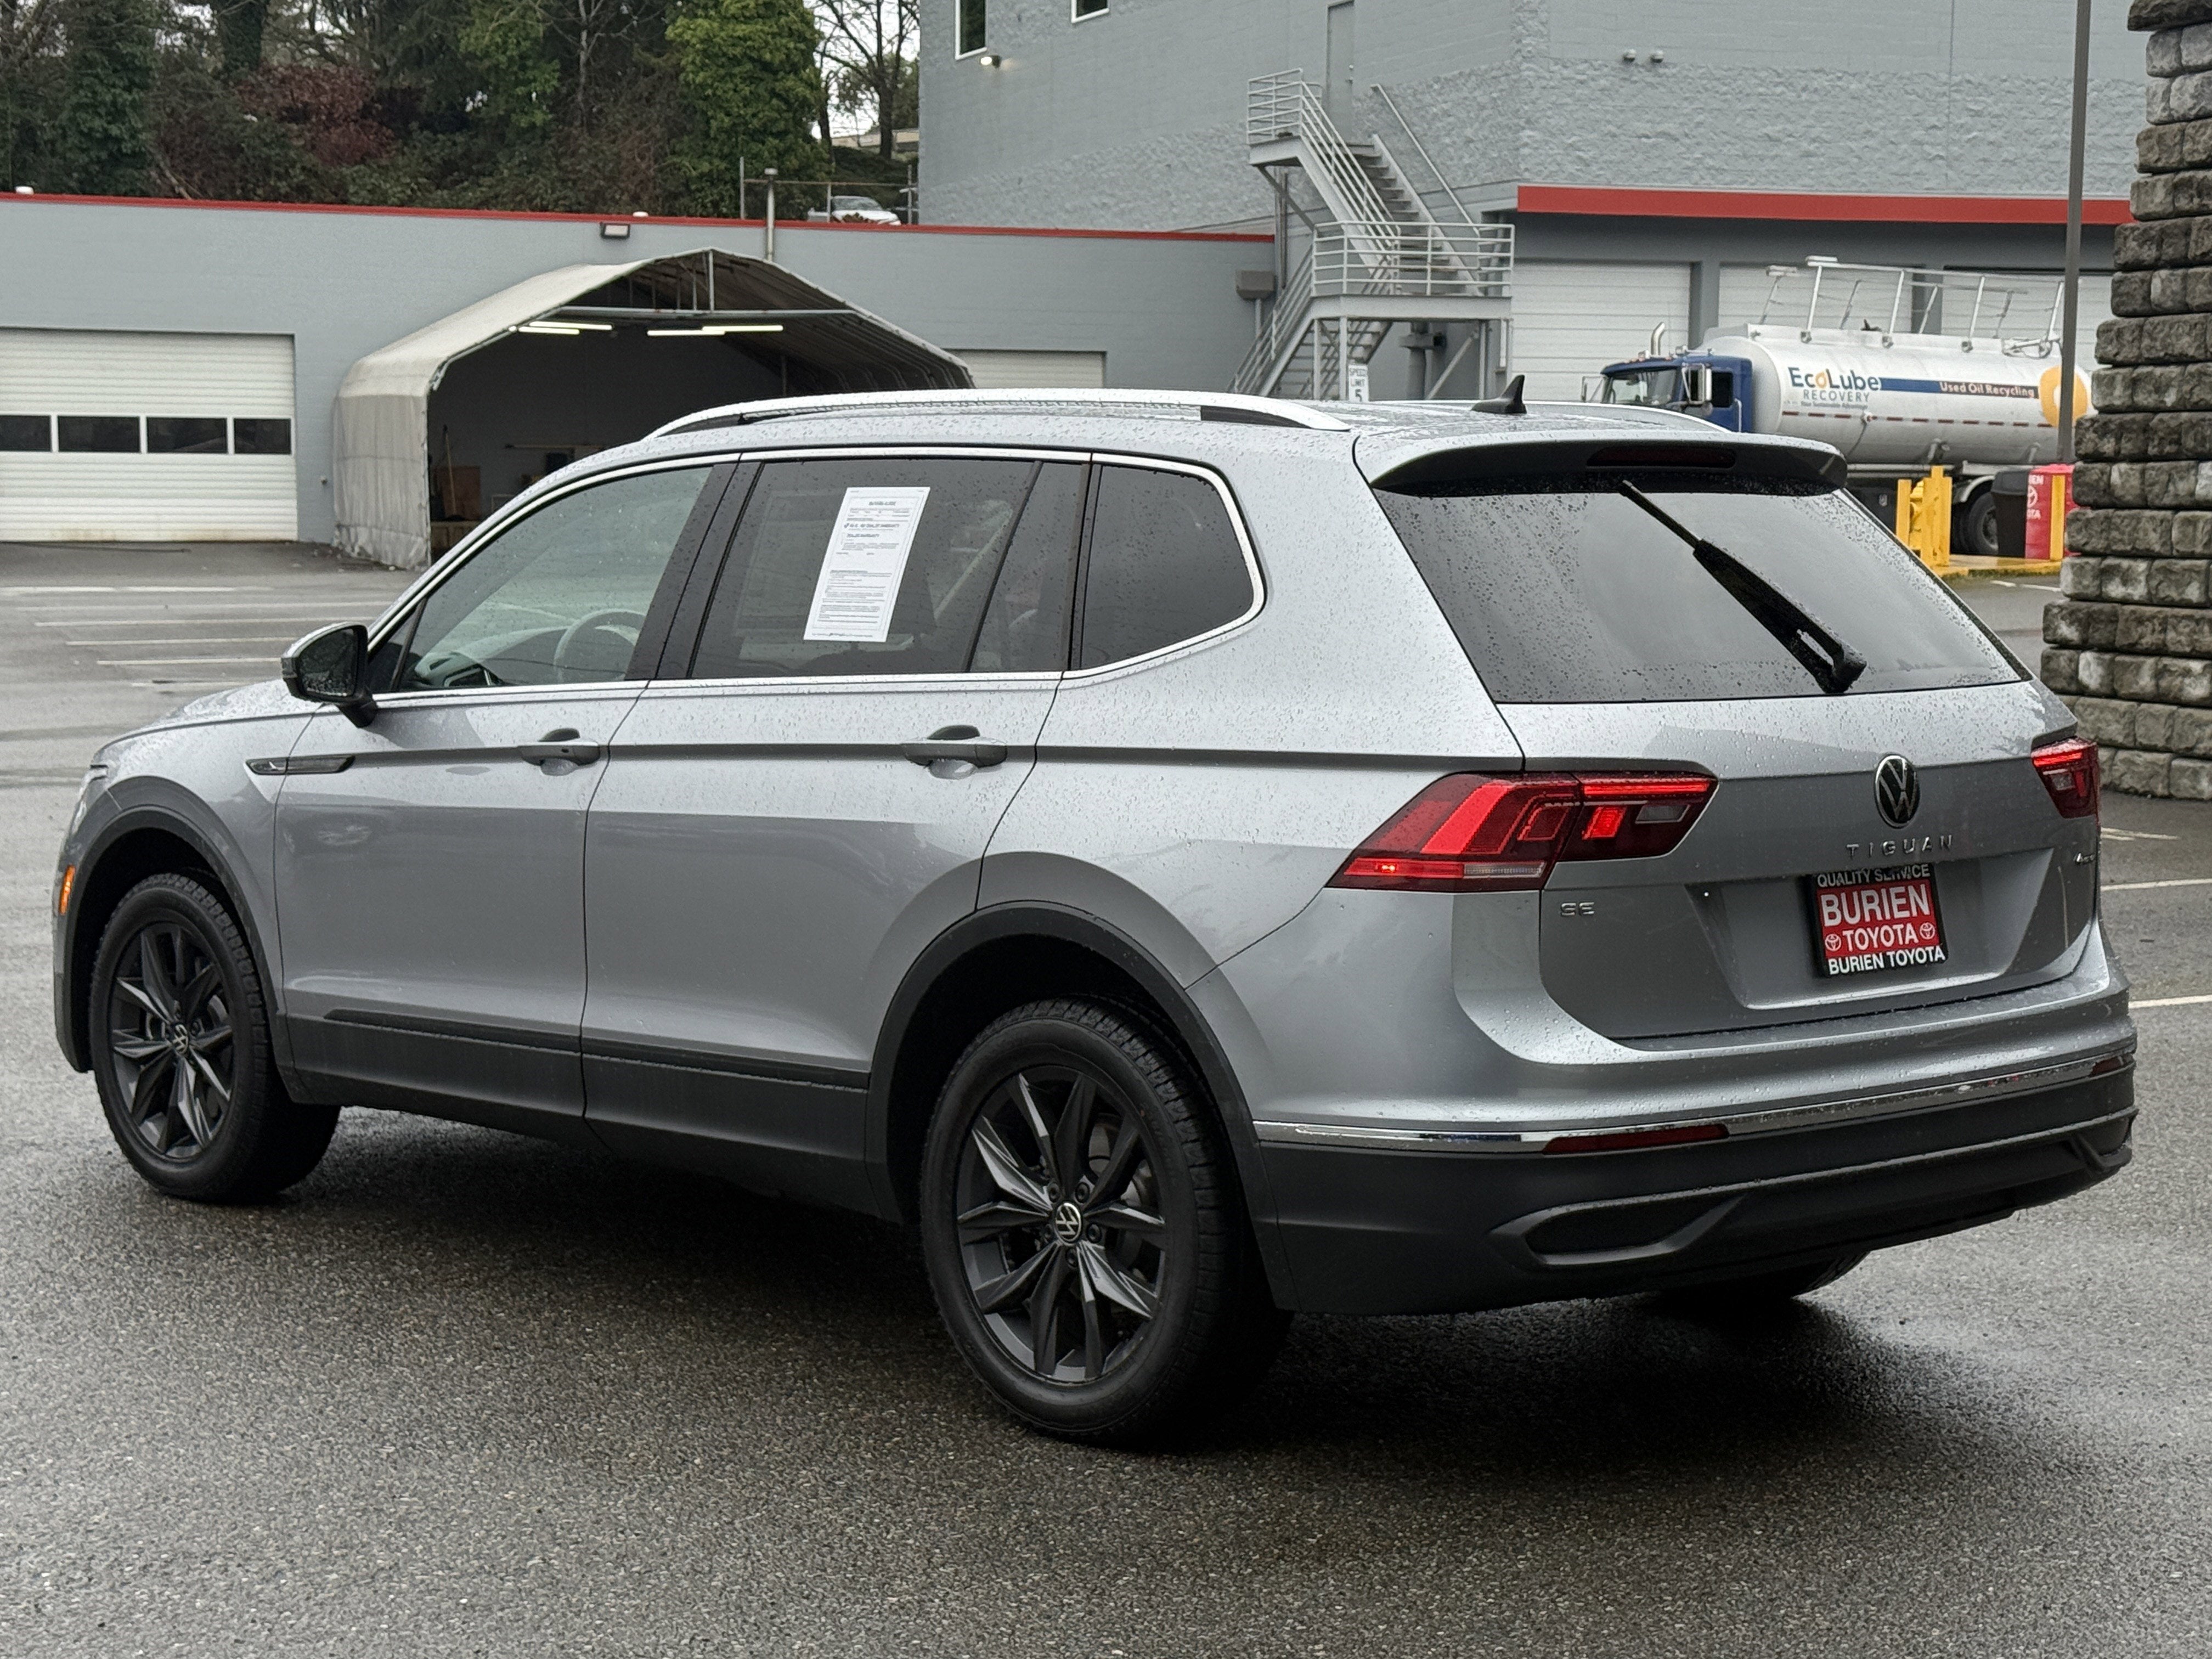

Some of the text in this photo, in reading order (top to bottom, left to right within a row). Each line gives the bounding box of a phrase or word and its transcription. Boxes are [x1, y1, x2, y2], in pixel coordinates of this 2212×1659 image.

[1788, 366, 1879, 391] EcoLube
[1939, 381, 2035, 398] Used Oil Recycling
[1803, 389, 1870, 402] RECOVERY
[1847, 835, 1951, 858] TIGUAN
[1818, 868, 1871, 887] QUALITY
[1561, 902, 1595, 916] SE
[1820, 884, 1930, 927] BURIEN
[1843, 923, 1919, 952] TOYOTA
[1829, 945, 1945, 975] BURIEN TOYOTA
